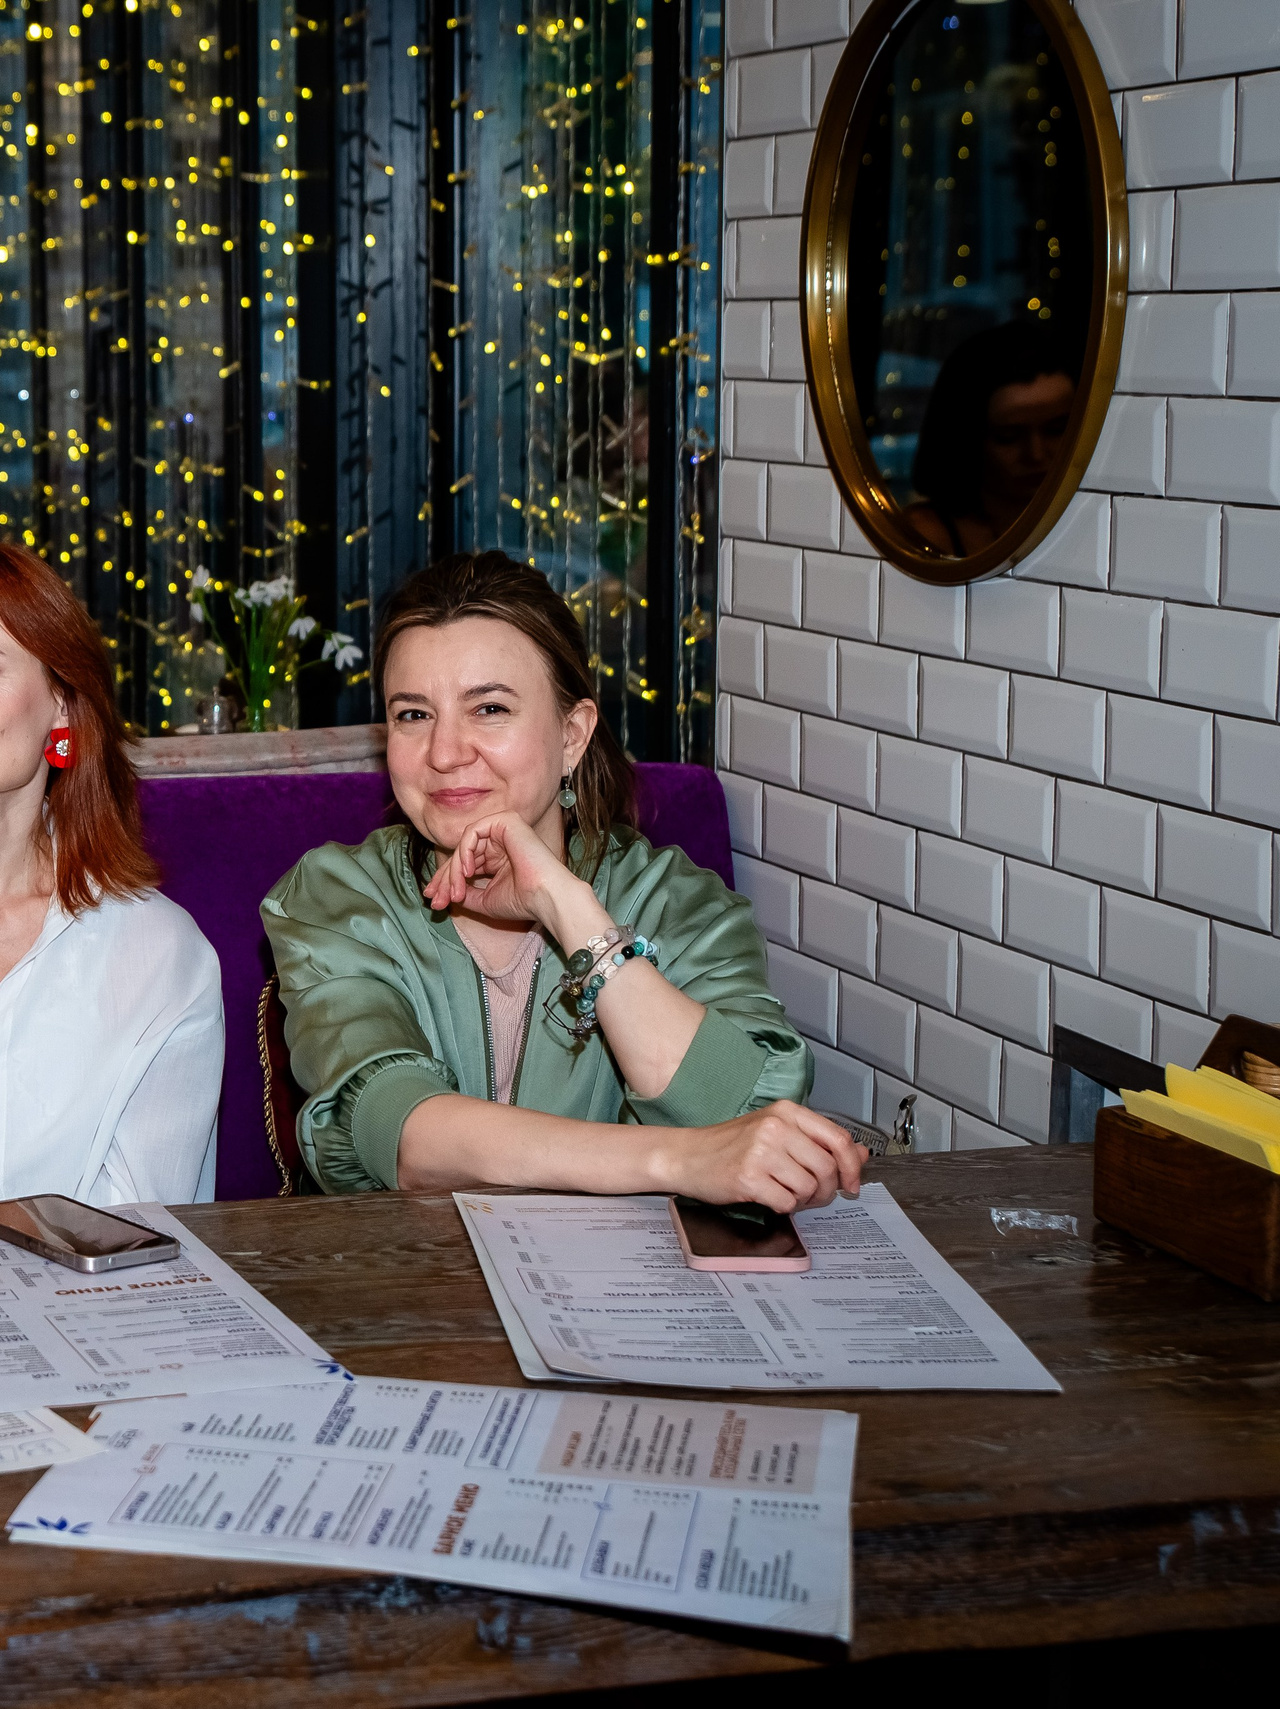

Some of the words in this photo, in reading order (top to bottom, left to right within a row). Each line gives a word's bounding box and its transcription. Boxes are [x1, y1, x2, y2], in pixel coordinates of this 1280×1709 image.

[814, 1212, 869, 1220] БУРГЕРЫ
[127, 1277, 212, 1289] БАРНОЕ
[54, 1286, 122, 1296] МЕНЮ
[146, 1292, 227, 1303] МОРОЖЕНОЕ
[180, 1305, 241, 1313] ВЫПЕЧКА
[189, 1316, 254, 1324] СЫРНИКИ
[221, 1350, 291, 1358] ЗАВТРАКИ
[607, 1353, 691, 1361] КОМПАНИЮ
[75, 1382, 130, 1391] SEVEN
[113, 1428, 139, 1449] SEVEN
[432, 1514, 467, 1555] БАРНОЕ
[451, 1482, 481, 1513] МЕНЮ
